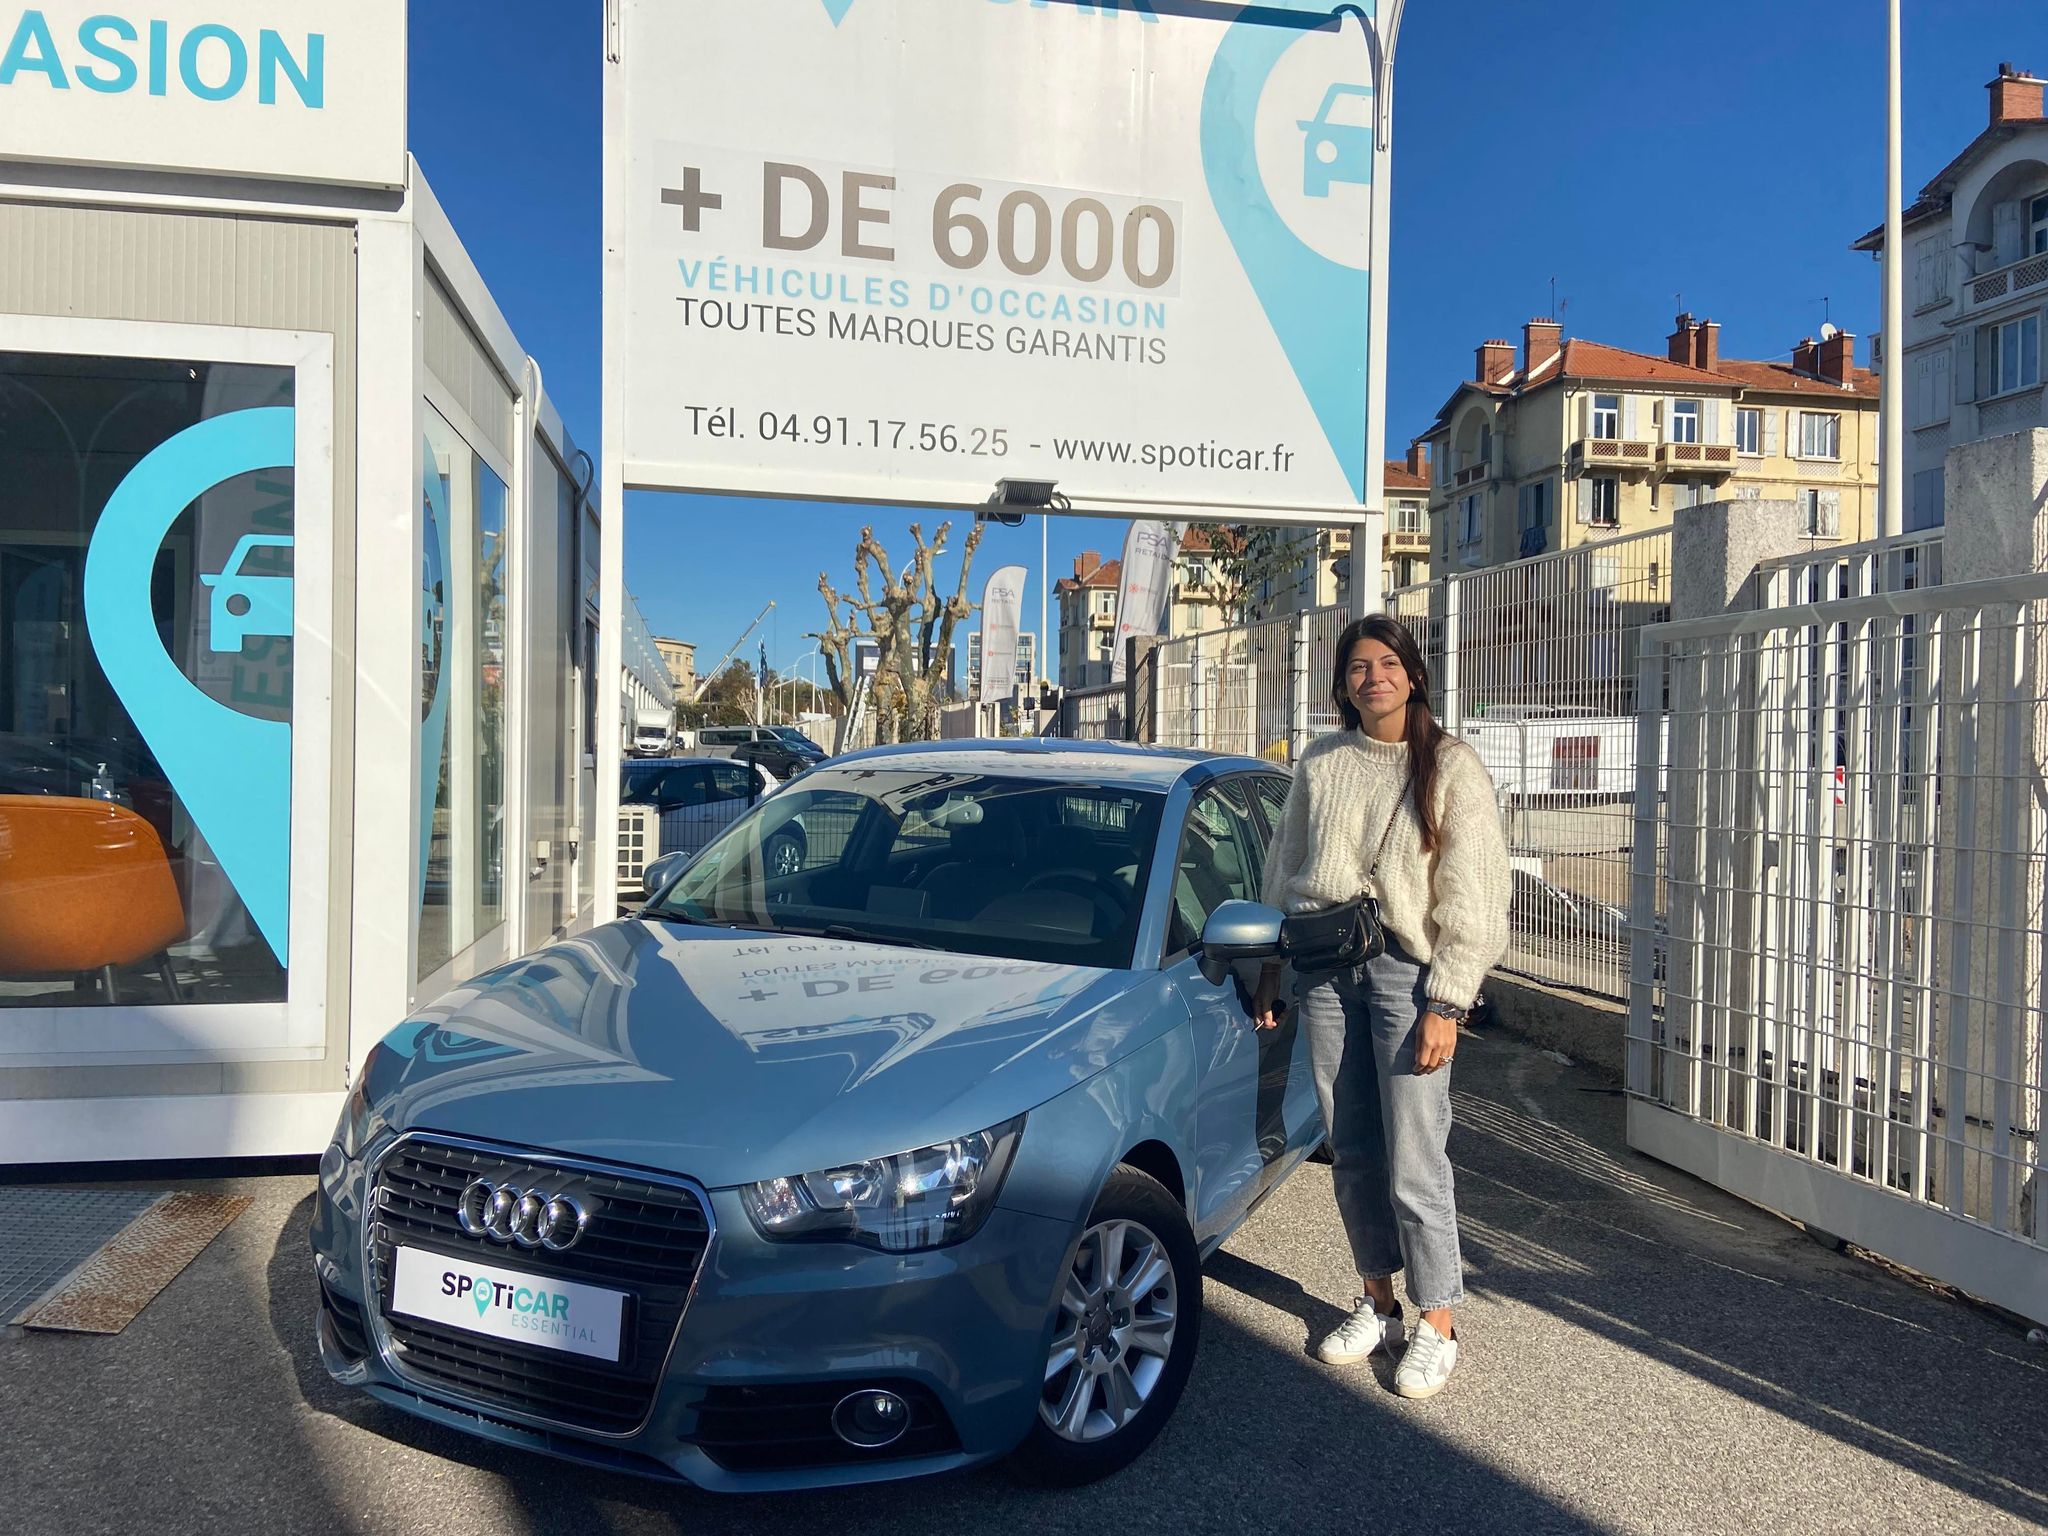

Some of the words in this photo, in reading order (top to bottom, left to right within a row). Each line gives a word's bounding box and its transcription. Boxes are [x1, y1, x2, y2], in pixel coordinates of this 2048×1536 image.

[0, 10, 325, 109] ASION
[763, 162, 897, 262] DE
[932, 183, 1175, 289] 6000
[677, 256, 910, 308] VÉHICULES
[929, 283, 1166, 330] D'OCCASION
[676, 296, 816, 337] TOUTES
[829, 311, 995, 351] MARQUES
[1006, 326, 1166, 365] GARANTIS
[684, 406, 745, 439] Tél.
[759, 411, 1009, 457] 04.91.17.56.25
[1053, 437, 1295, 473] www.spoticar.fr
[1137, 532, 1168, 549] PSA
[511, 1313, 598, 1343] ESSENTIAL
